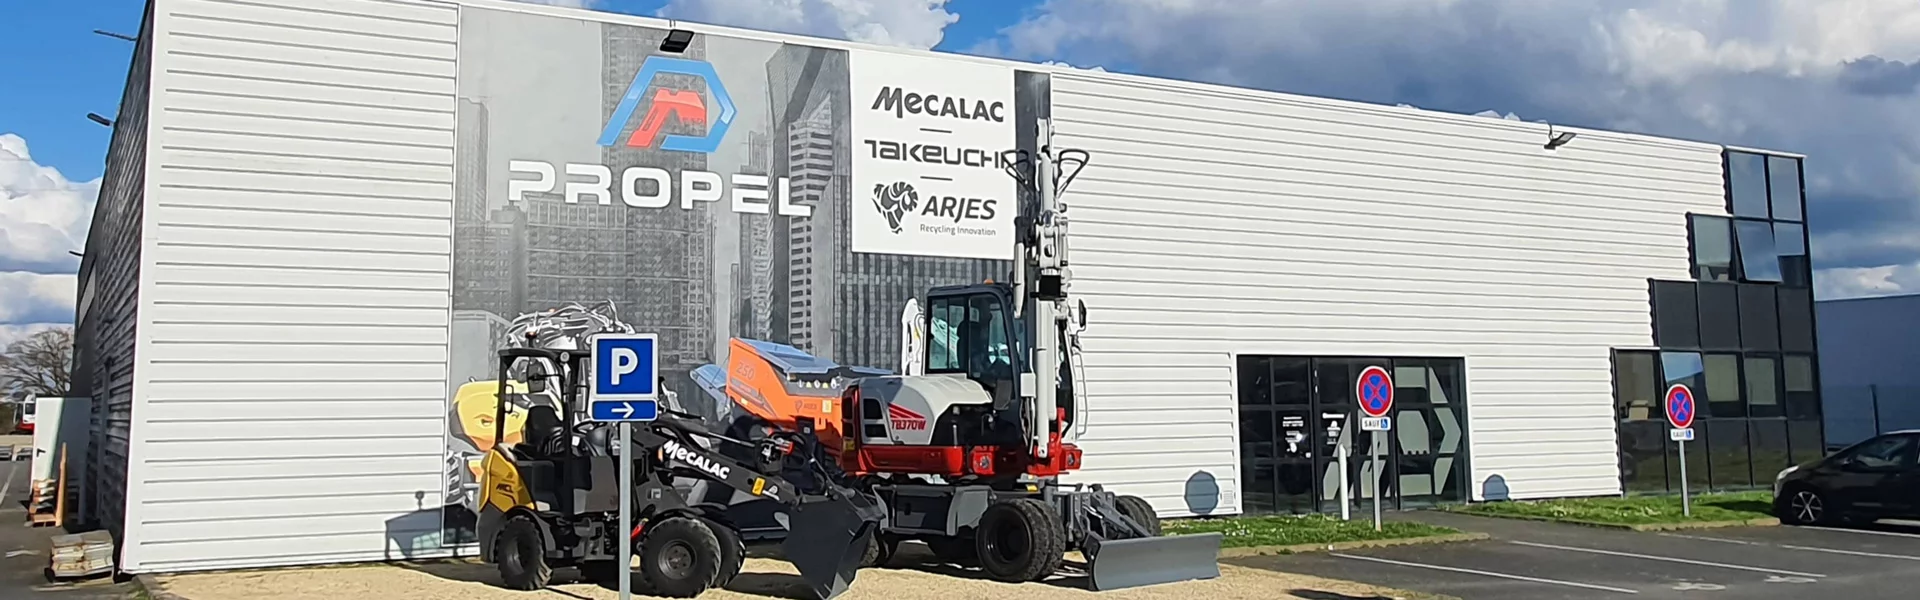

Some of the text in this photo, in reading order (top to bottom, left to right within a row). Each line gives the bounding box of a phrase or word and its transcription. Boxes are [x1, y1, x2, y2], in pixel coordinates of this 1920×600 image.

[508, 160, 812, 217] PROPEL
[921, 195, 997, 224] ARJES
[920, 223, 997, 236] Recycling Innovation
[611, 347, 639, 385] P
[891, 419, 927, 431] TB370W
